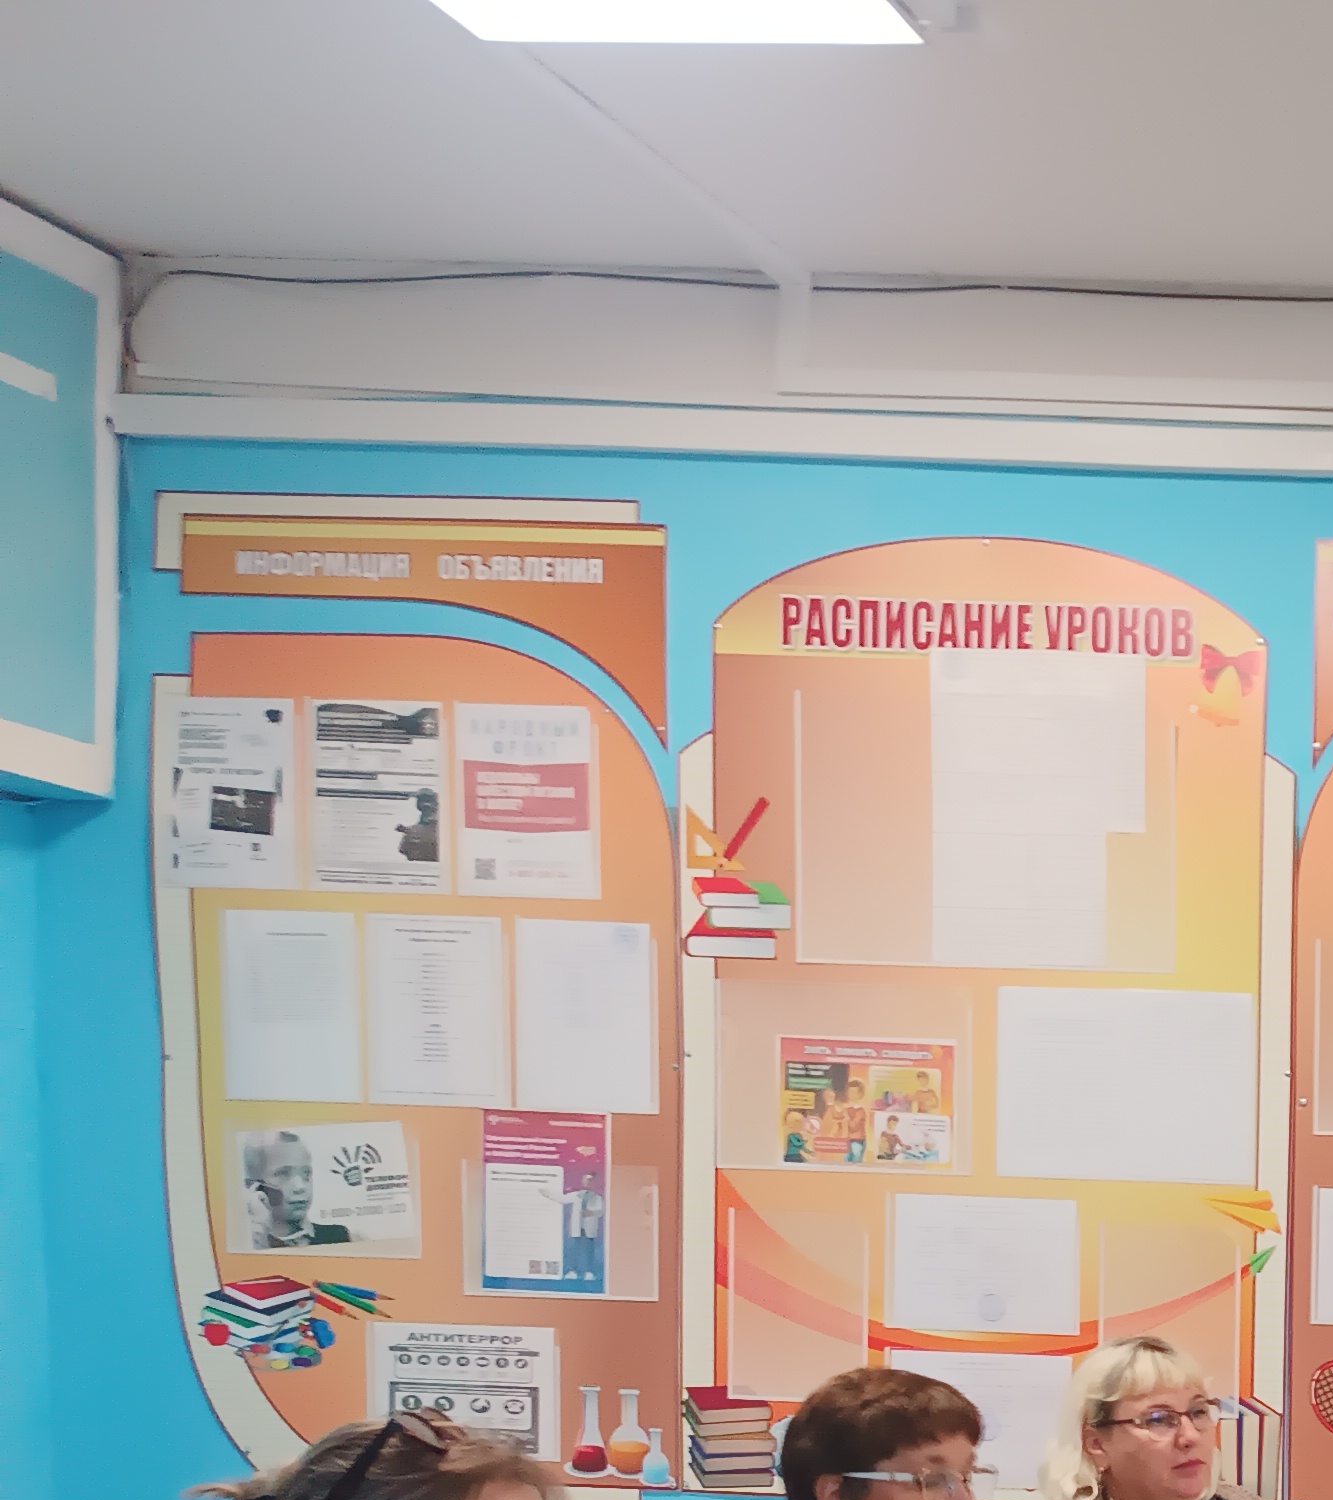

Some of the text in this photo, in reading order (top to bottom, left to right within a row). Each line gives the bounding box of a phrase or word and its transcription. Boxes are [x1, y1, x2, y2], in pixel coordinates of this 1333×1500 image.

[235, 549, 604, 584] ИНФОРМАЦИЯ ОБЪЯВЛЕНИЯ
[781, 596, 1195, 659] РАСПИСАНИЕ УРОКОВ
[407, 1332, 524, 1345] АНТИТЕРРОР
